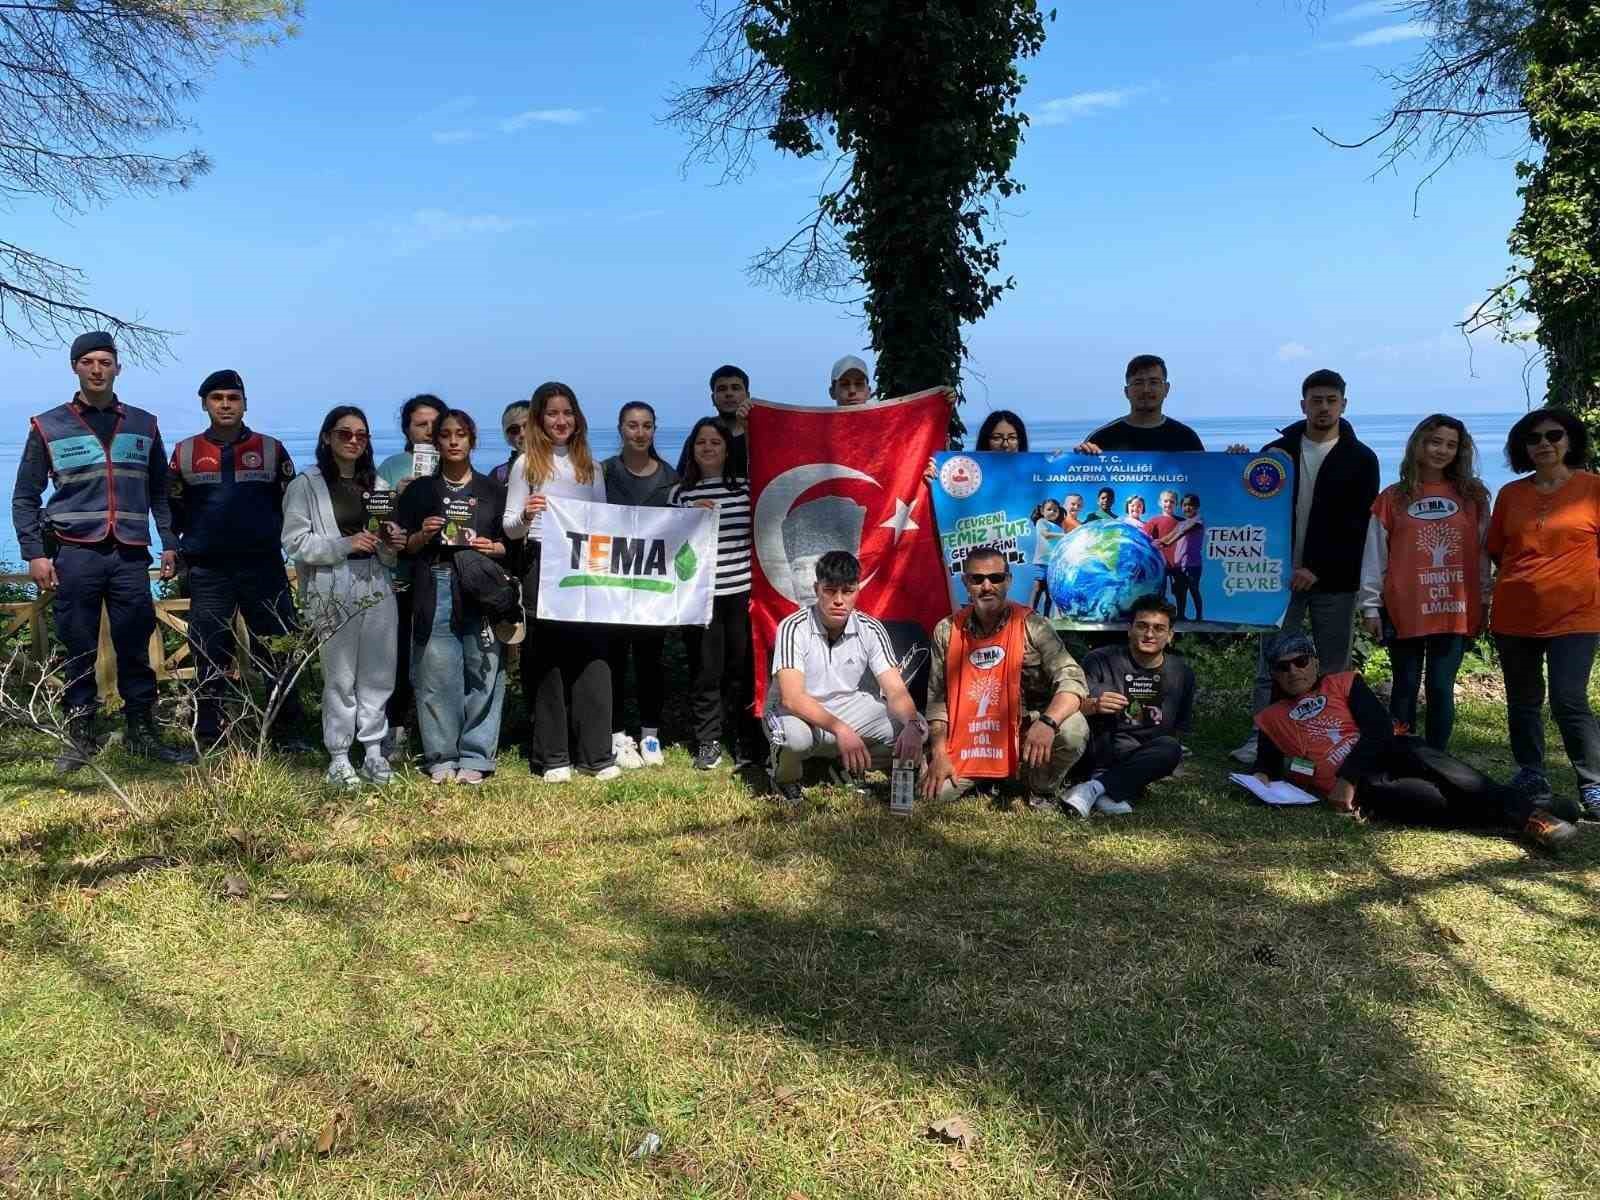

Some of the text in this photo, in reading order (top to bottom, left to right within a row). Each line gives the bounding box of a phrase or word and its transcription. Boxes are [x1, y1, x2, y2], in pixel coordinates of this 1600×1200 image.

[1099, 455, 1122, 463] T. C.
[1067, 463, 1153, 473] AYDIN VALİLİĞİ
[1032, 473, 1188, 482] İL JANDARMA KOMUTANLIĞI
[943, 528, 988, 548] TEMİZ
[1208, 526, 1264, 542] TEMİZ
[566, 531, 667, 576] TEMA
[1209, 542, 1262, 558] İNSAN
[1225, 558, 1281, 574] TEMİZ
[1225, 576, 1278, 593] ÇEVRE
